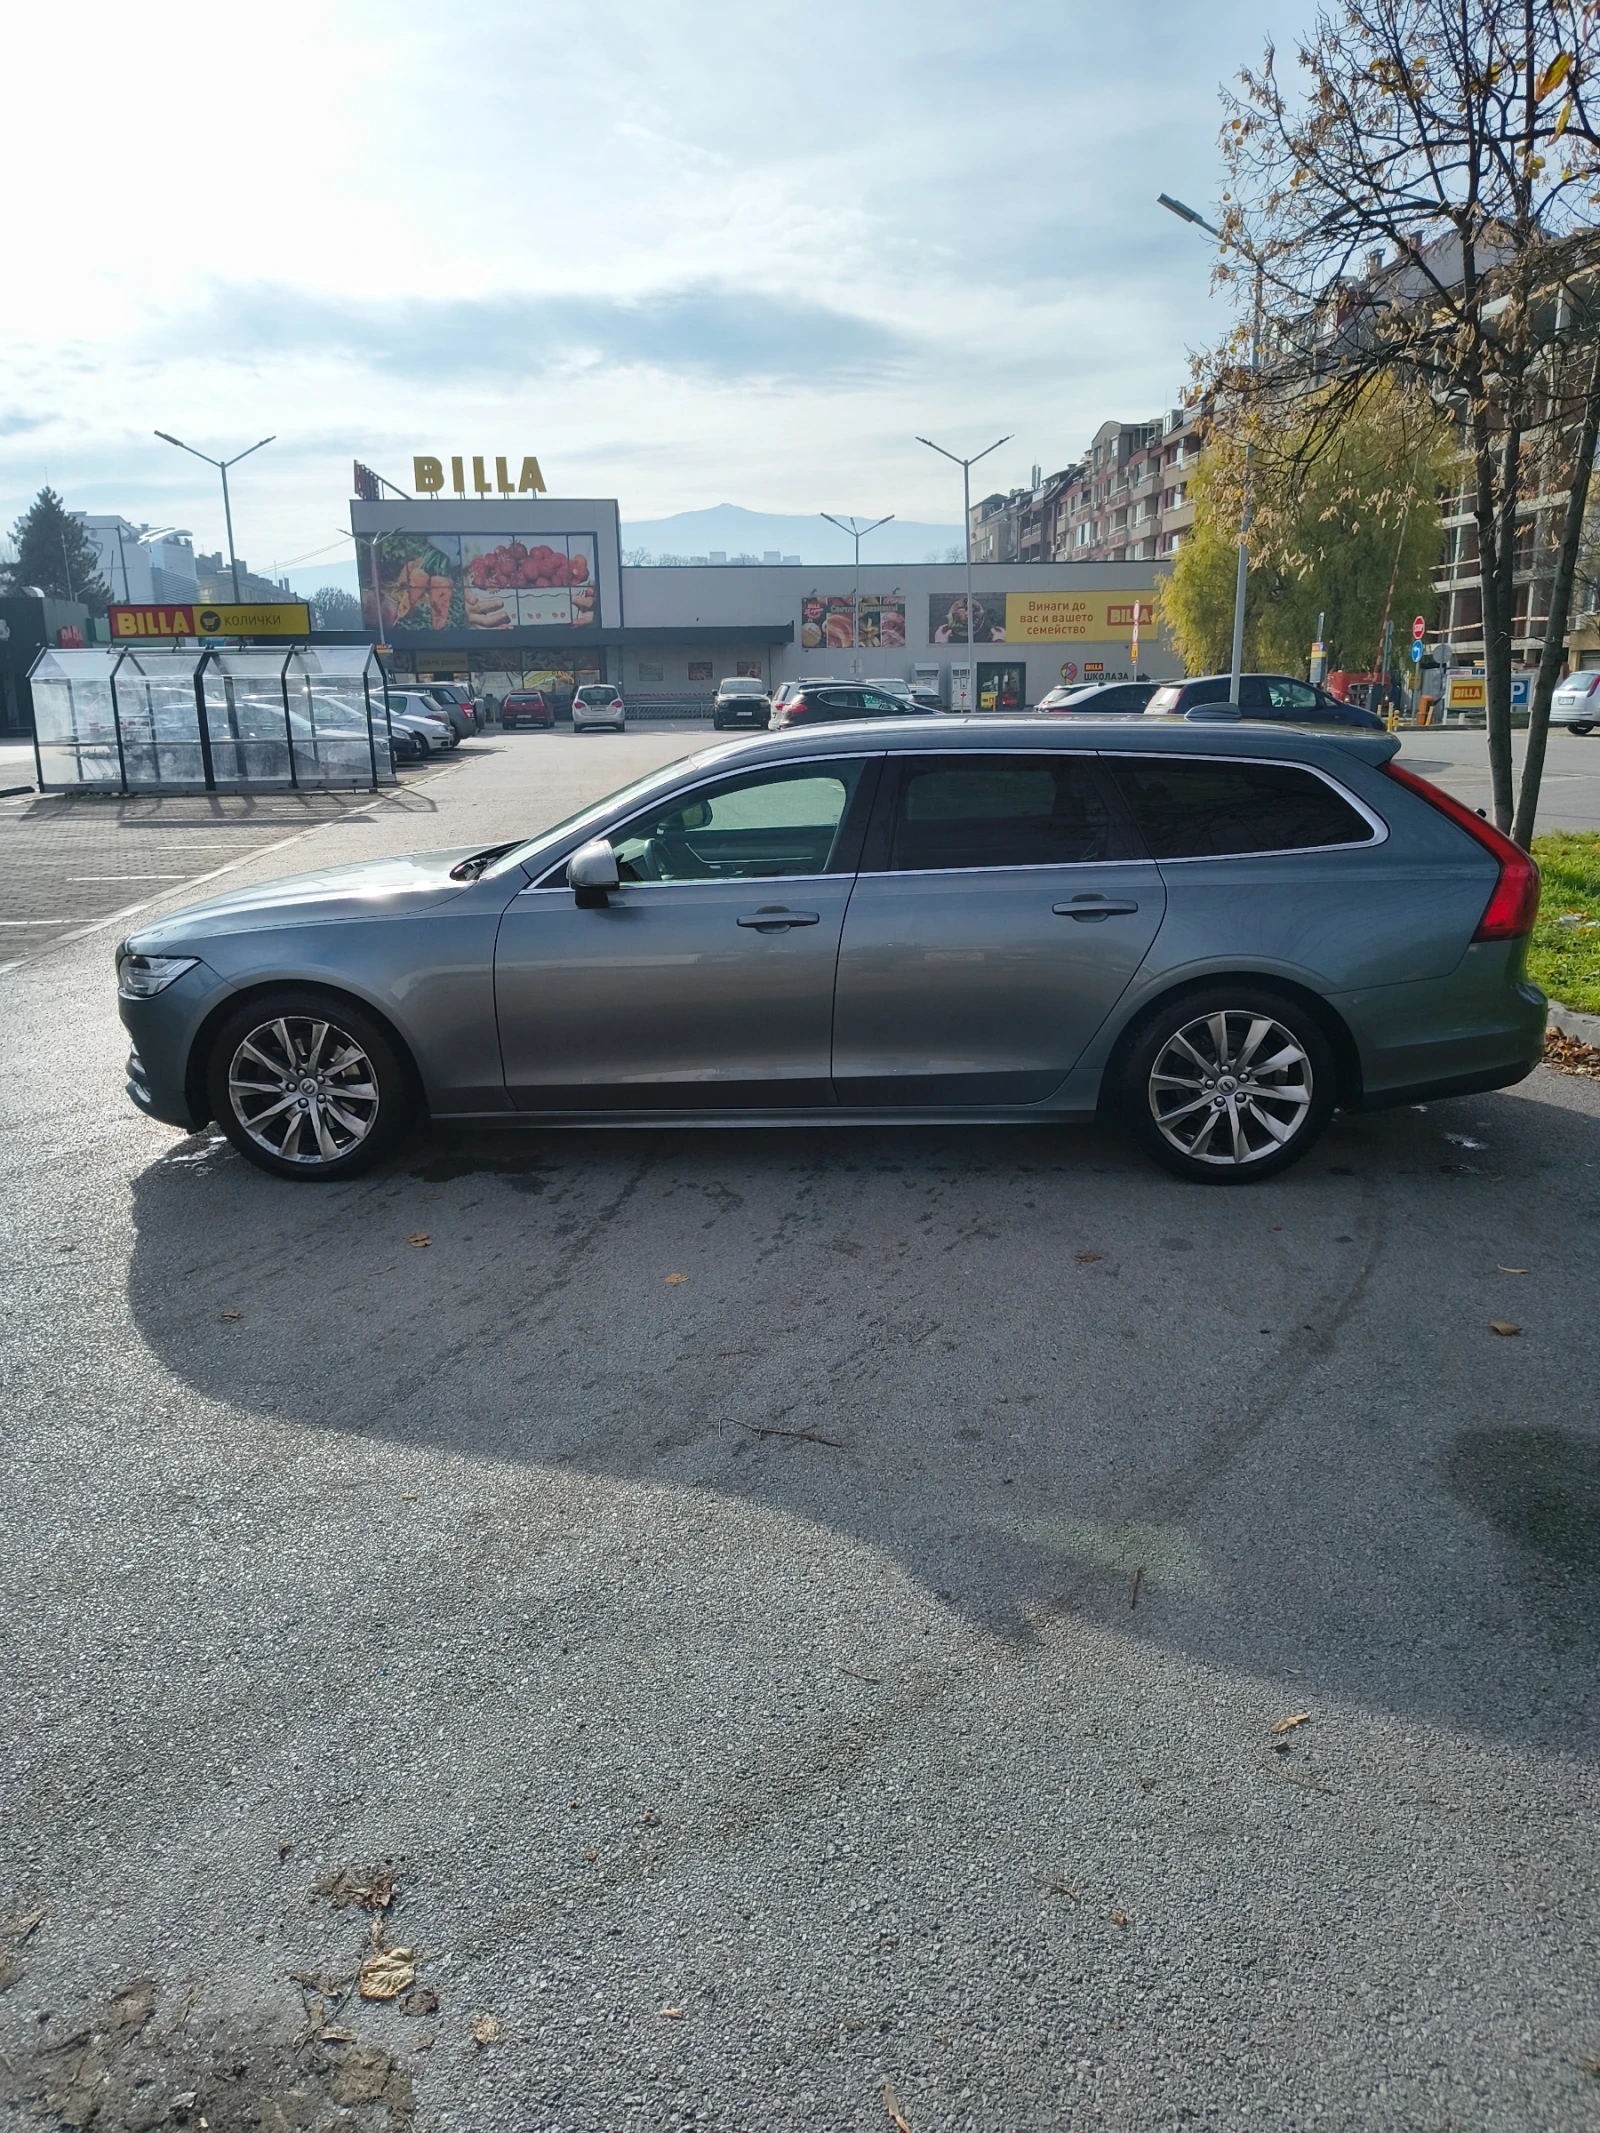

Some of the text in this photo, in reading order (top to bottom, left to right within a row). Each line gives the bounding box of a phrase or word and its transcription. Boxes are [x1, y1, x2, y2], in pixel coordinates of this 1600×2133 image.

[413, 456, 547, 492] BILLA
[1028, 601, 1086, 612] Винаги до
[224, 615, 281, 626] КОЛИЧКИ
[1020, 615, 1039, 623] вас
[1052, 613, 1094, 623] вашето
[1110, 608, 1150, 623] BILA
[116, 611, 191, 635] BILLA
[1027, 624, 1086, 635] семейство
[1084, 672, 1117, 681] ШКОЛА
[1453, 688, 1481, 698] BILLA
[1511, 682, 1525, 703] P
